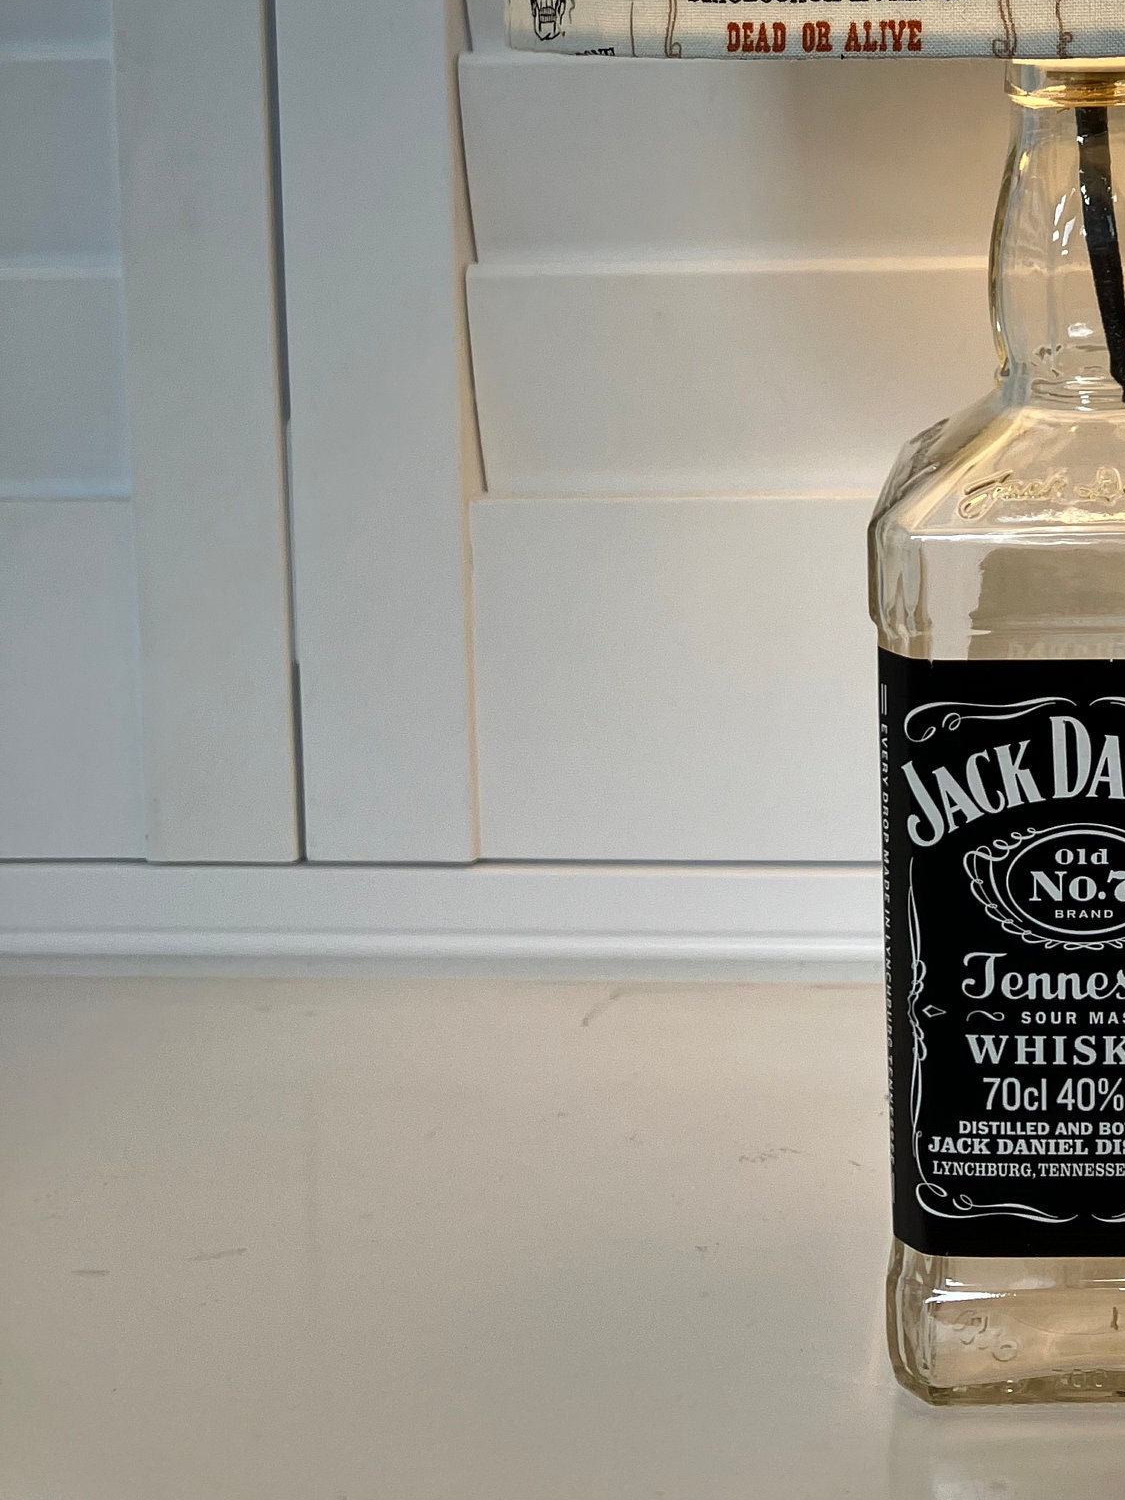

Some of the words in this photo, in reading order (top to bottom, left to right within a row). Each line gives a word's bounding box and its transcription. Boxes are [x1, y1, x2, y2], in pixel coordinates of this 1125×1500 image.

[727, 21, 787, 53] DEAD
[802, 21, 834, 53] OR
[844, 19, 923, 52] ALIVE
[880, 722, 889, 786] EVERY
[901, 738, 1046, 848] JACK
[881, 791, 890, 844] DROP
[1054, 847, 1109, 866] Old
[883, 849, 891, 903] MADE
[1054, 908, 1115, 919] BRAND
[1020, 1010, 1082, 1025] SOUR
[982, 1077, 1048, 1112] 70cl
[1055, 1077, 1124, 1112] 40%
[958, 1120, 1050, 1136] DISTILLED
[1055, 1121, 1093, 1136] AND
[927, 1137, 991, 1156] JACK
[996, 1137, 1089, 1156] DANIEL
[933, 1161, 1037, 1179] LYNCHBURG,
